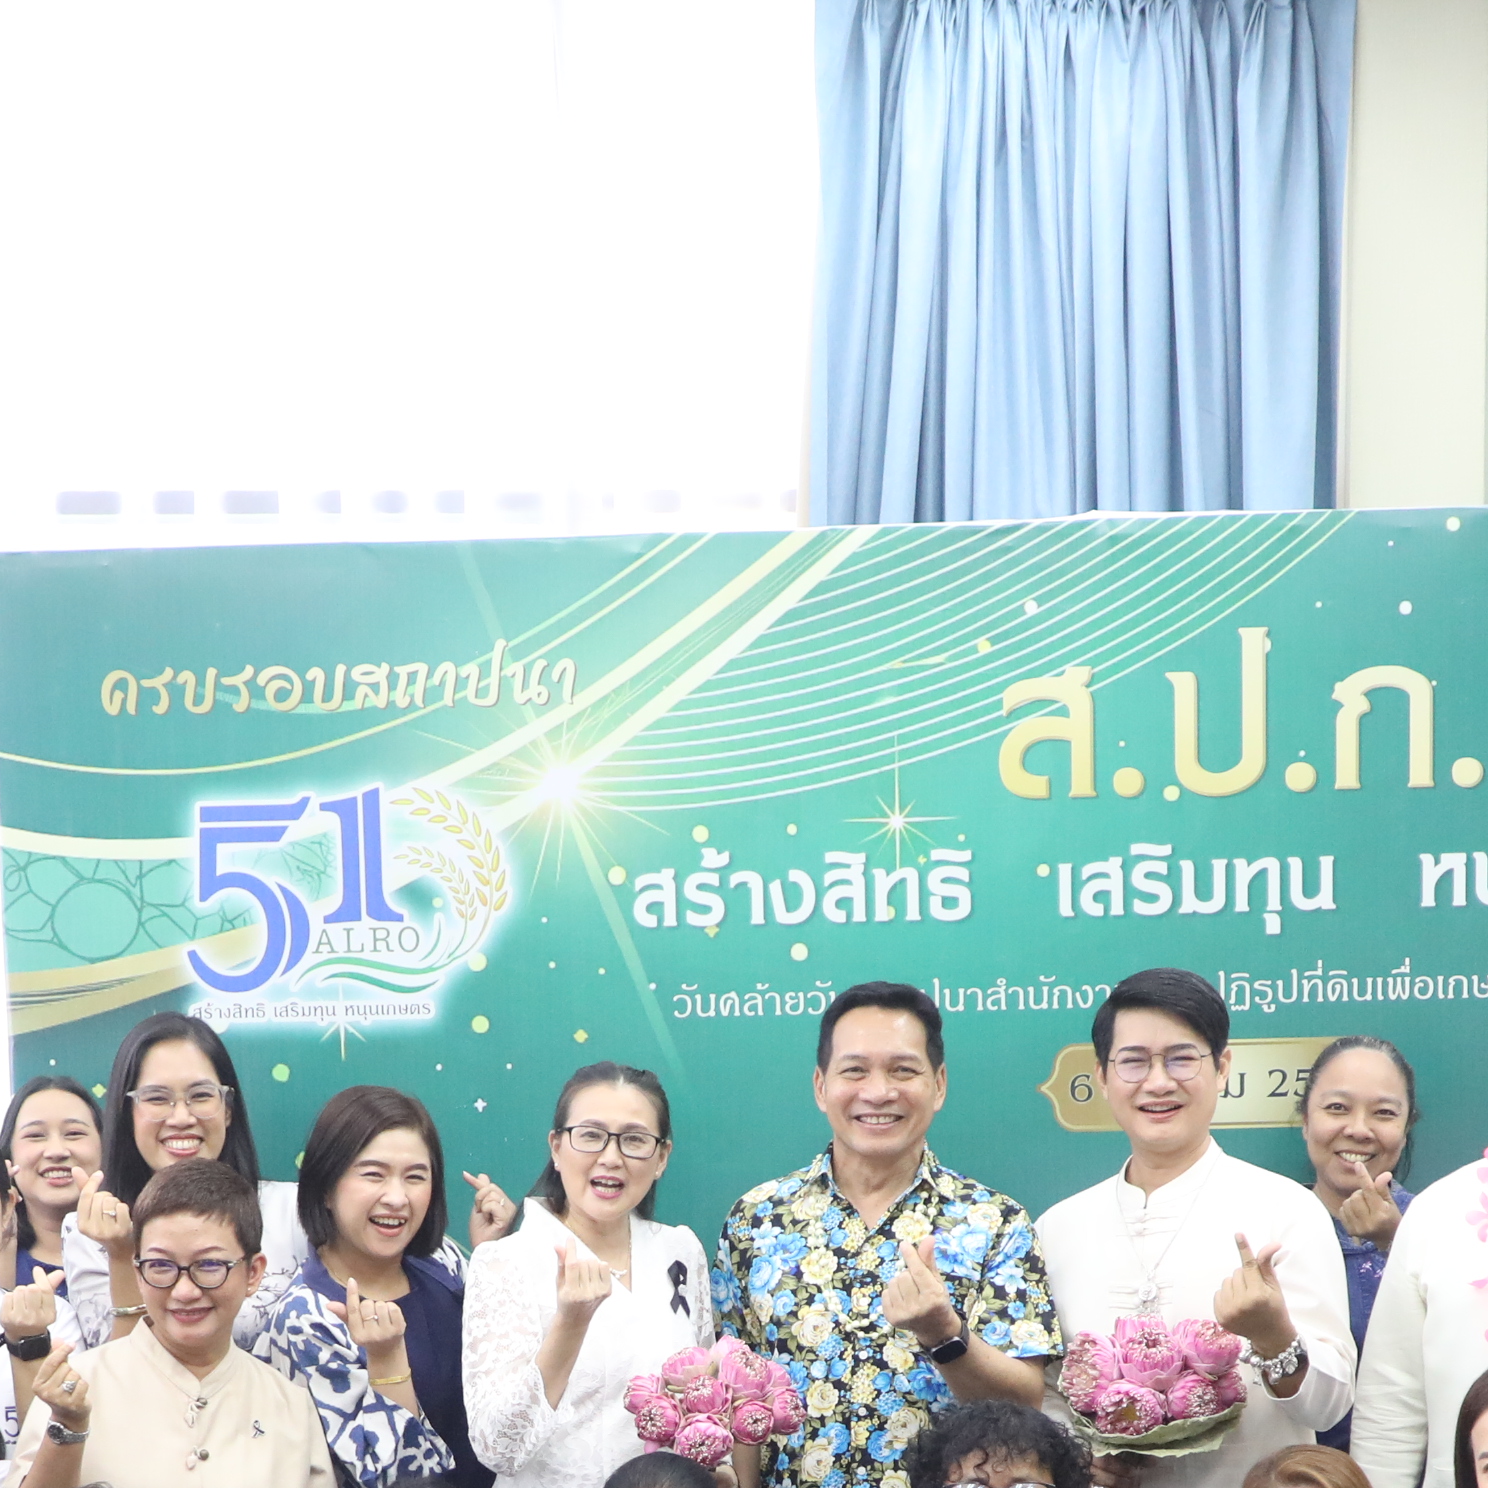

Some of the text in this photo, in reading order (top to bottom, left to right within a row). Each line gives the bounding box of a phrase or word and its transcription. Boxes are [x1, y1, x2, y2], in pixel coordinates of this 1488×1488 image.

[100, 639, 577, 716] ครบรอบสถาปนา
[998, 627, 1485, 800] ส.ป.ก.
[187, 786, 405, 993] 51
[632, 846, 973, 928] สร้างสิทธิ
[1057, 842, 1337, 934] เสริมทุน
[312, 926, 420, 954] ALRO
[192, 1001, 431, 1022] สร้างสิทธิ เสริมทุน หนุนเกษตร
[1069, 1073, 1094, 1102] 6
[1267, 1068, 1313, 1098] 25
